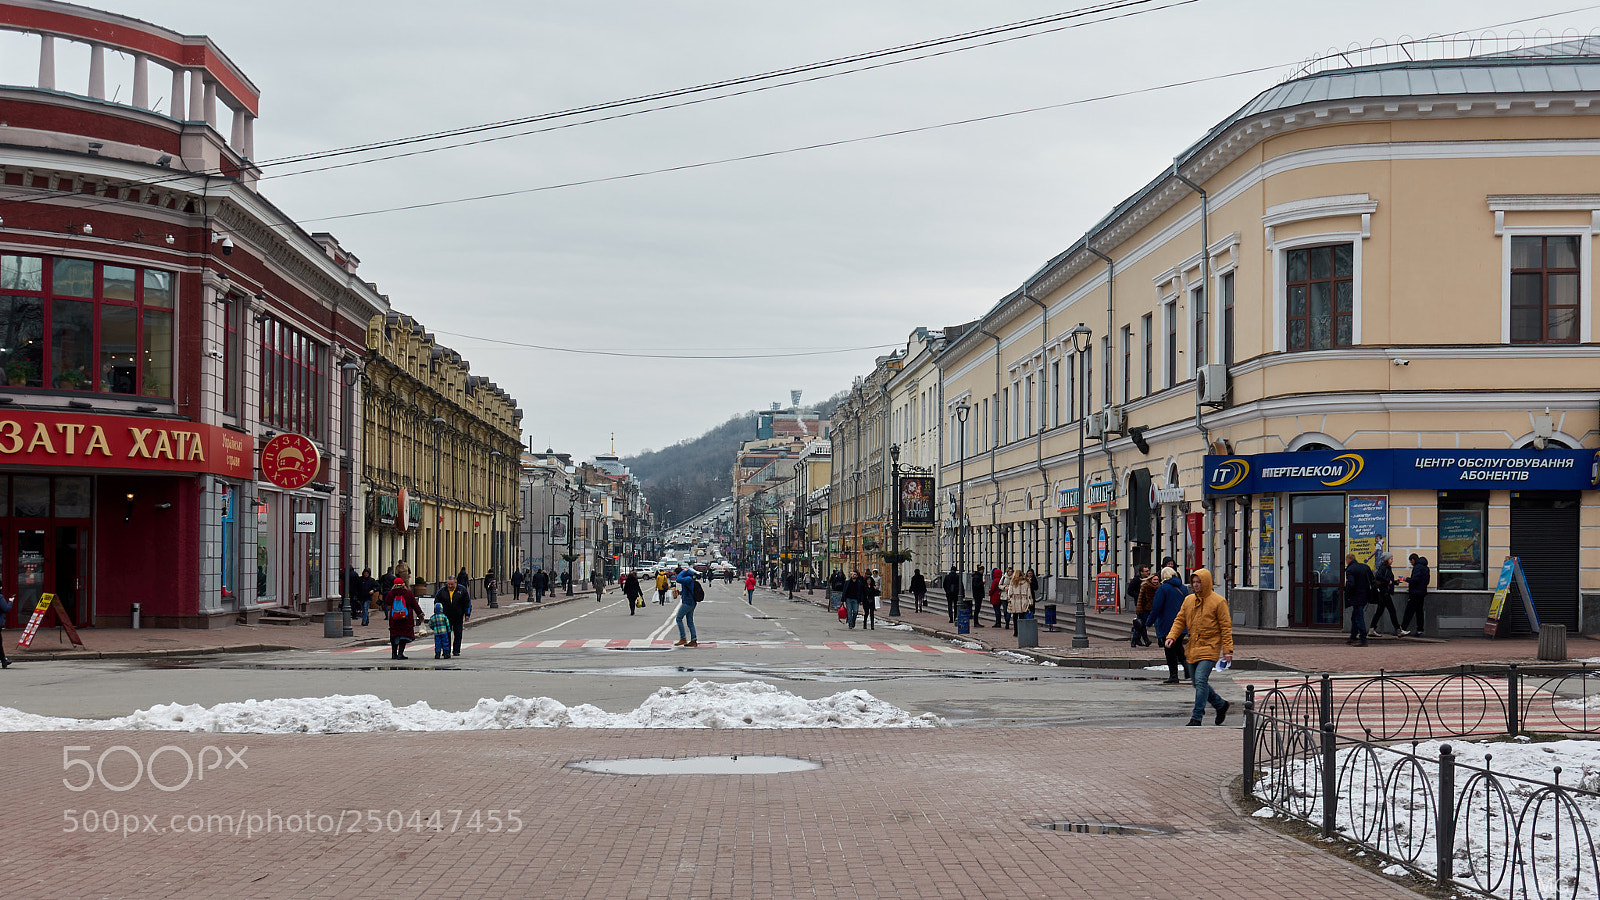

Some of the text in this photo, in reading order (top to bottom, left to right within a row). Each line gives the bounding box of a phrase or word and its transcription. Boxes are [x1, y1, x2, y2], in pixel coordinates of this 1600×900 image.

[127, 427, 206, 462] ХАТА
[265, 436, 315, 464] ПУЗАТА
[1415, 458, 1575, 469] ЦЕНТР ОБСЛУГОВУВАННЯ
[271, 471, 309, 486] ХАТА
[1460, 471, 1530, 481] АБОНЕНТІВ
